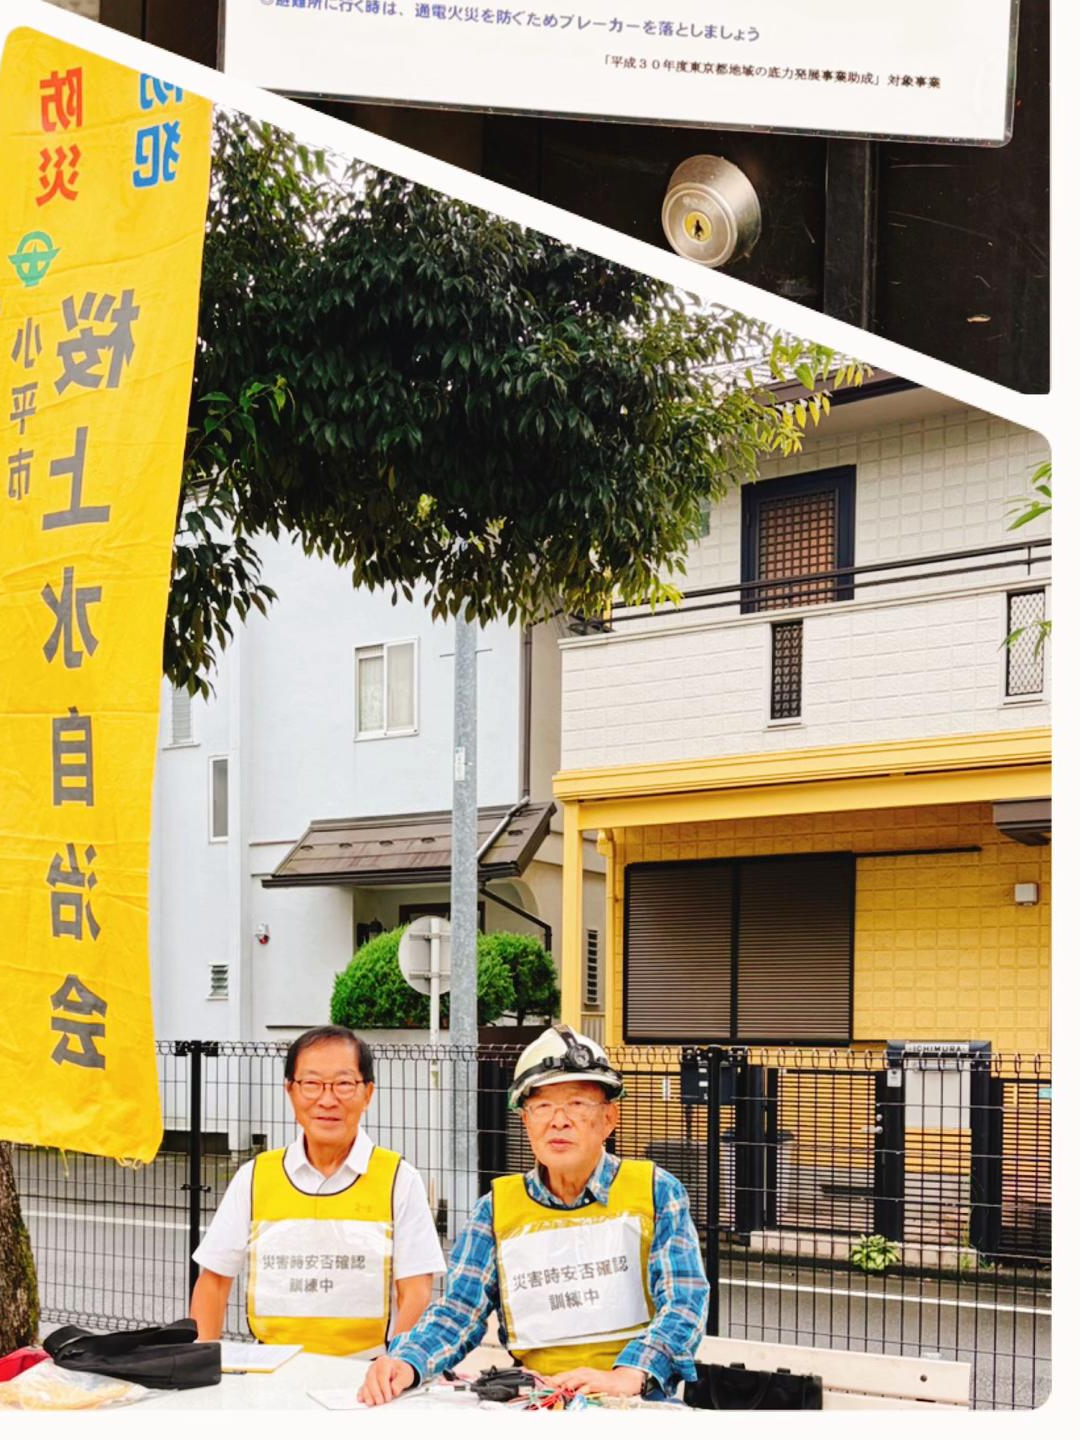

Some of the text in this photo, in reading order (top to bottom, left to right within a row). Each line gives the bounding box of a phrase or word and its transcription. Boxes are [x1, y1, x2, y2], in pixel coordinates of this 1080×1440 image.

[262, 1253, 366, 1273] 災害時安否確認
[288, 1276, 335, 1294] 訓練中
[511, 1255, 629, 1294] 災害時安否確認
[548, 1288, 601, 1312] 訓練中
